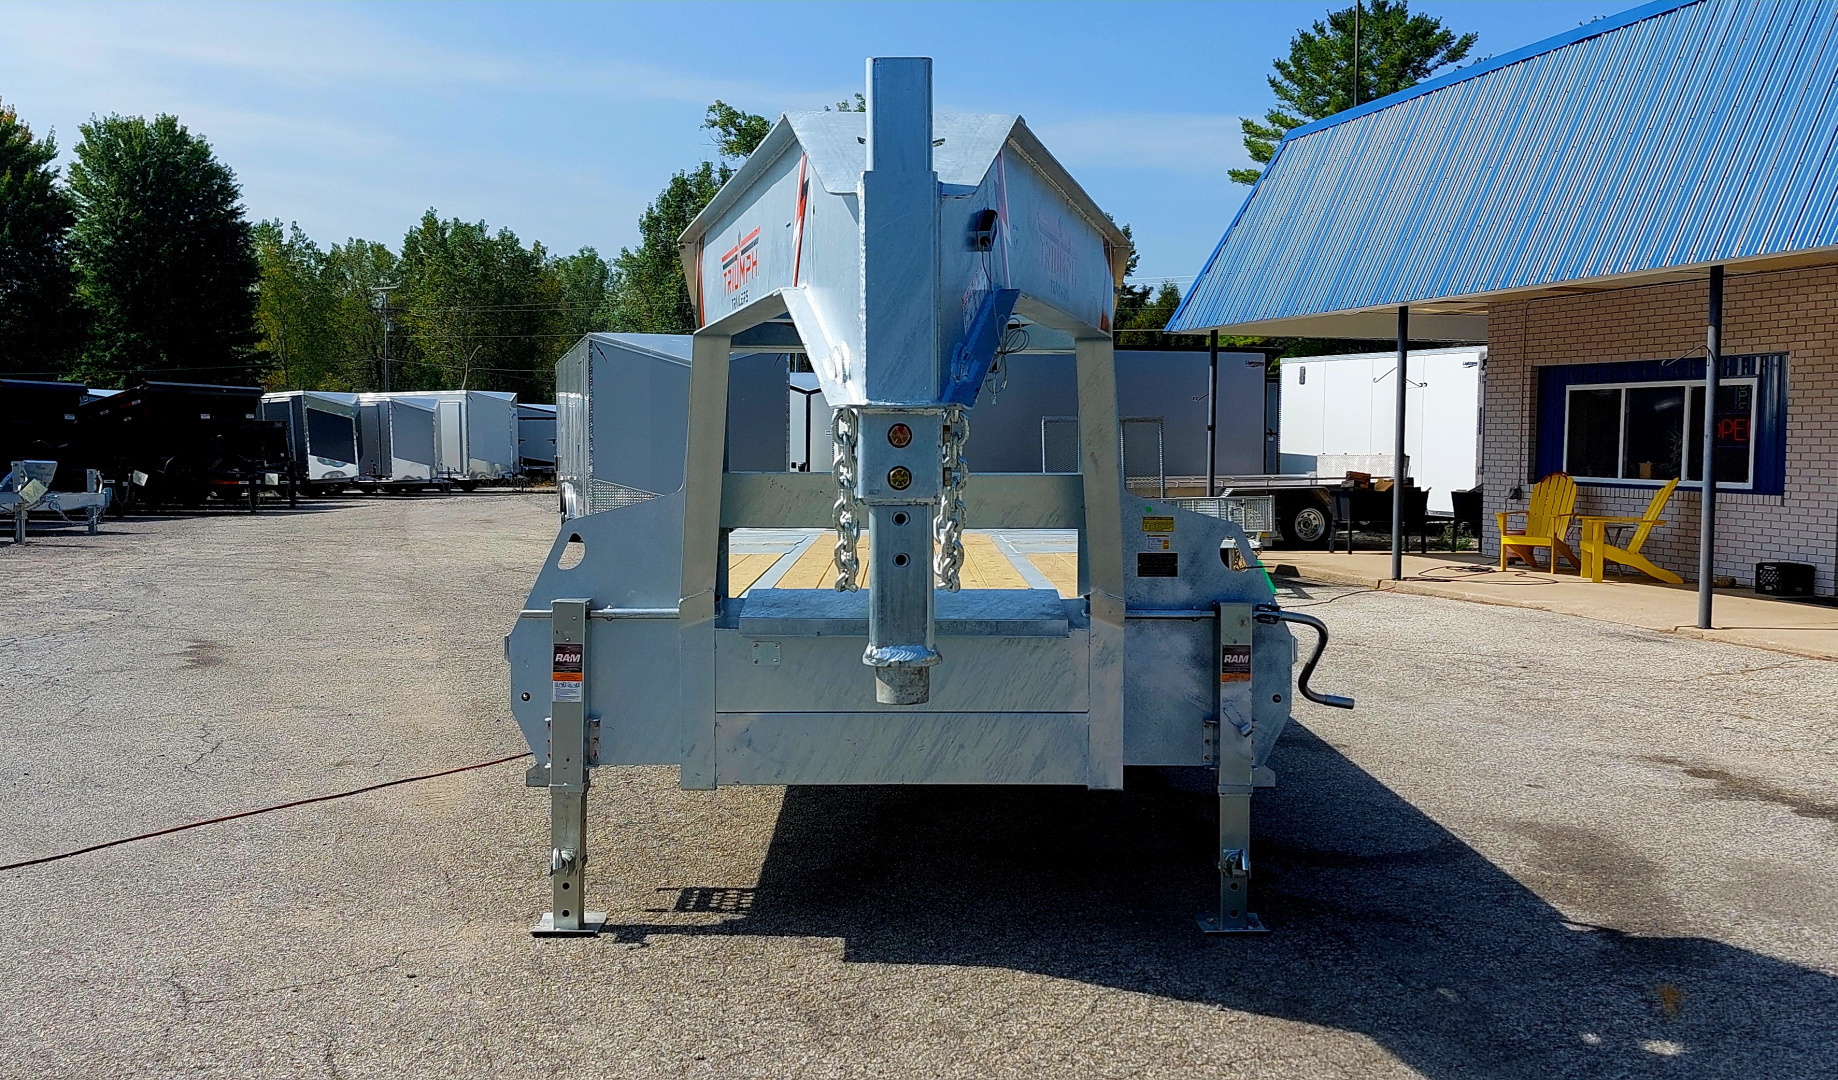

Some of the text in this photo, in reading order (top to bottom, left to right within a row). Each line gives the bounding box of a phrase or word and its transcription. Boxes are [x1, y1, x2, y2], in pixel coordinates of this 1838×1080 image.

[723, 247, 758, 298] TRIUMPH
[555, 653, 581, 663] RAM
[1223, 654, 1249, 664] RAM
